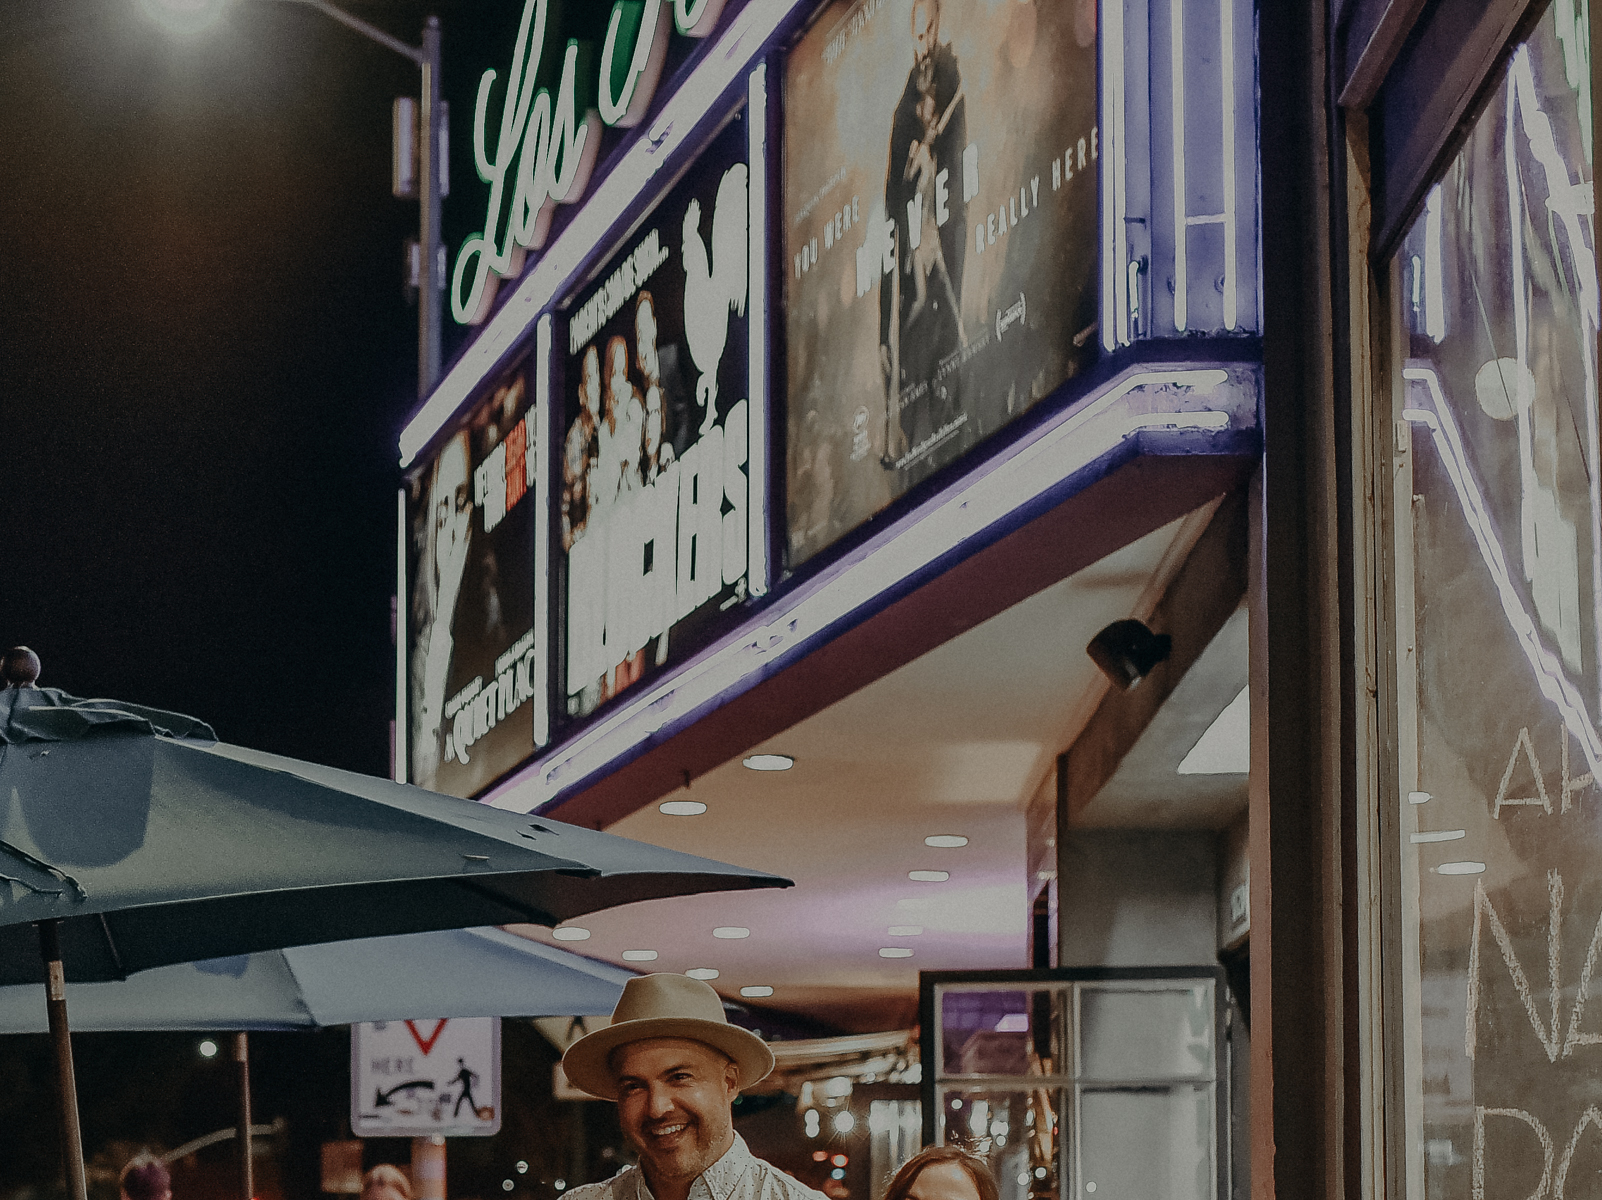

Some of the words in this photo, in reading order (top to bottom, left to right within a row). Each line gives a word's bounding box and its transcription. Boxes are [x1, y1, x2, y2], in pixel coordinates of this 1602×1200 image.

[793, 236, 818, 280] YOU
[823, 194, 861, 250] WERE
[855, 142, 981, 298] NEVER
[974, 175, 1041, 255] REALLY
[1051, 126, 1099, 192] HERE
